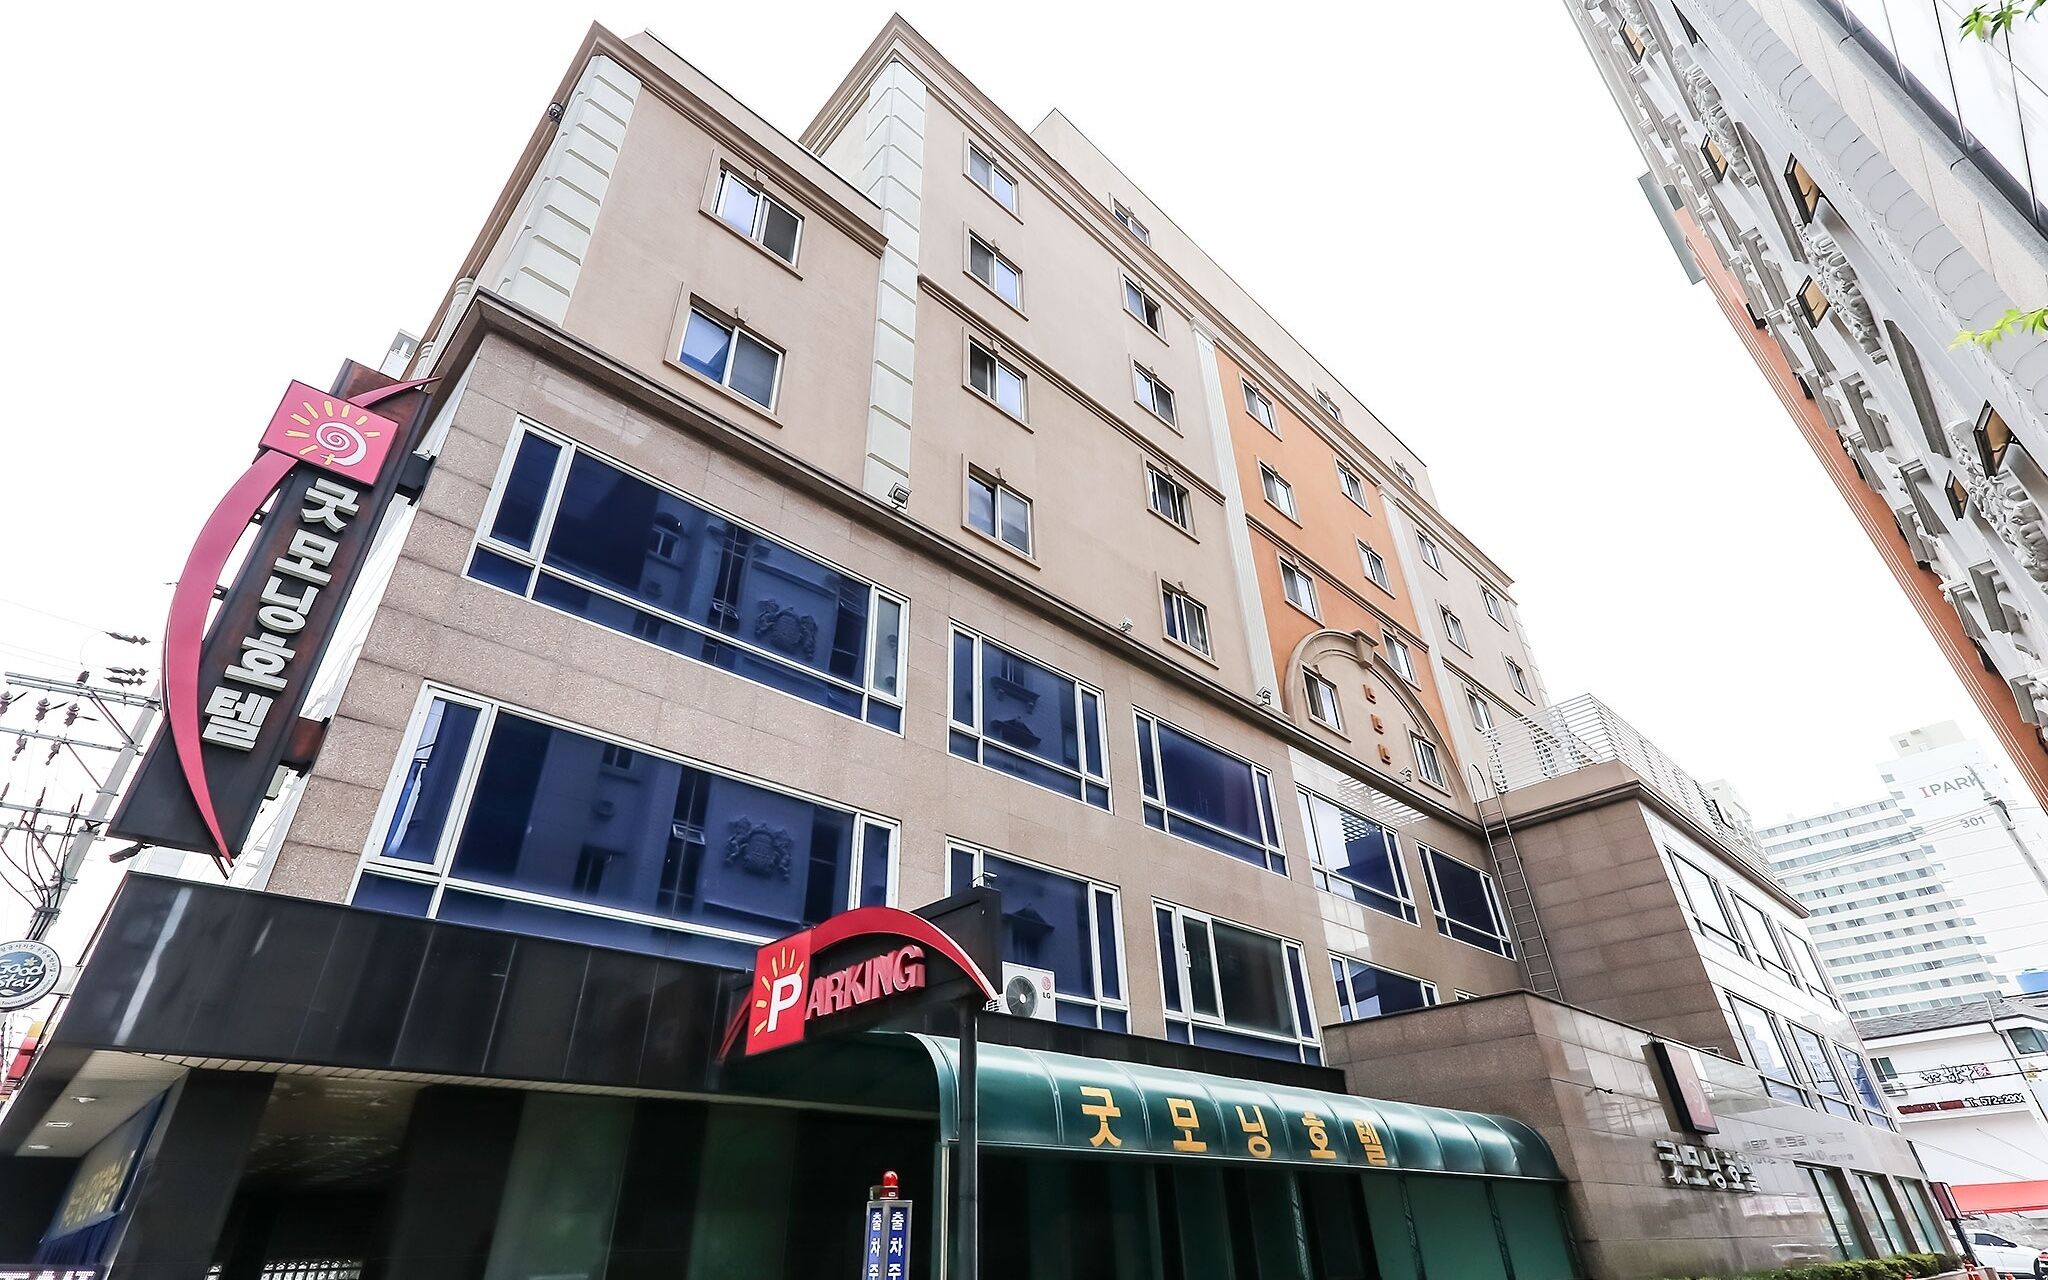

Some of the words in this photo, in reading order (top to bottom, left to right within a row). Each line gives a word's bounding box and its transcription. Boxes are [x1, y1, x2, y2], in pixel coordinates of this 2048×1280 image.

[201, 478, 360, 752] 굿모닝호텔
[1960, 816, 1986, 828] 301
[767, 944, 925, 1033] PARKING
[1042, 991, 1051, 999] LG
[1079, 1085, 1390, 1167] 굿모닝호텔
